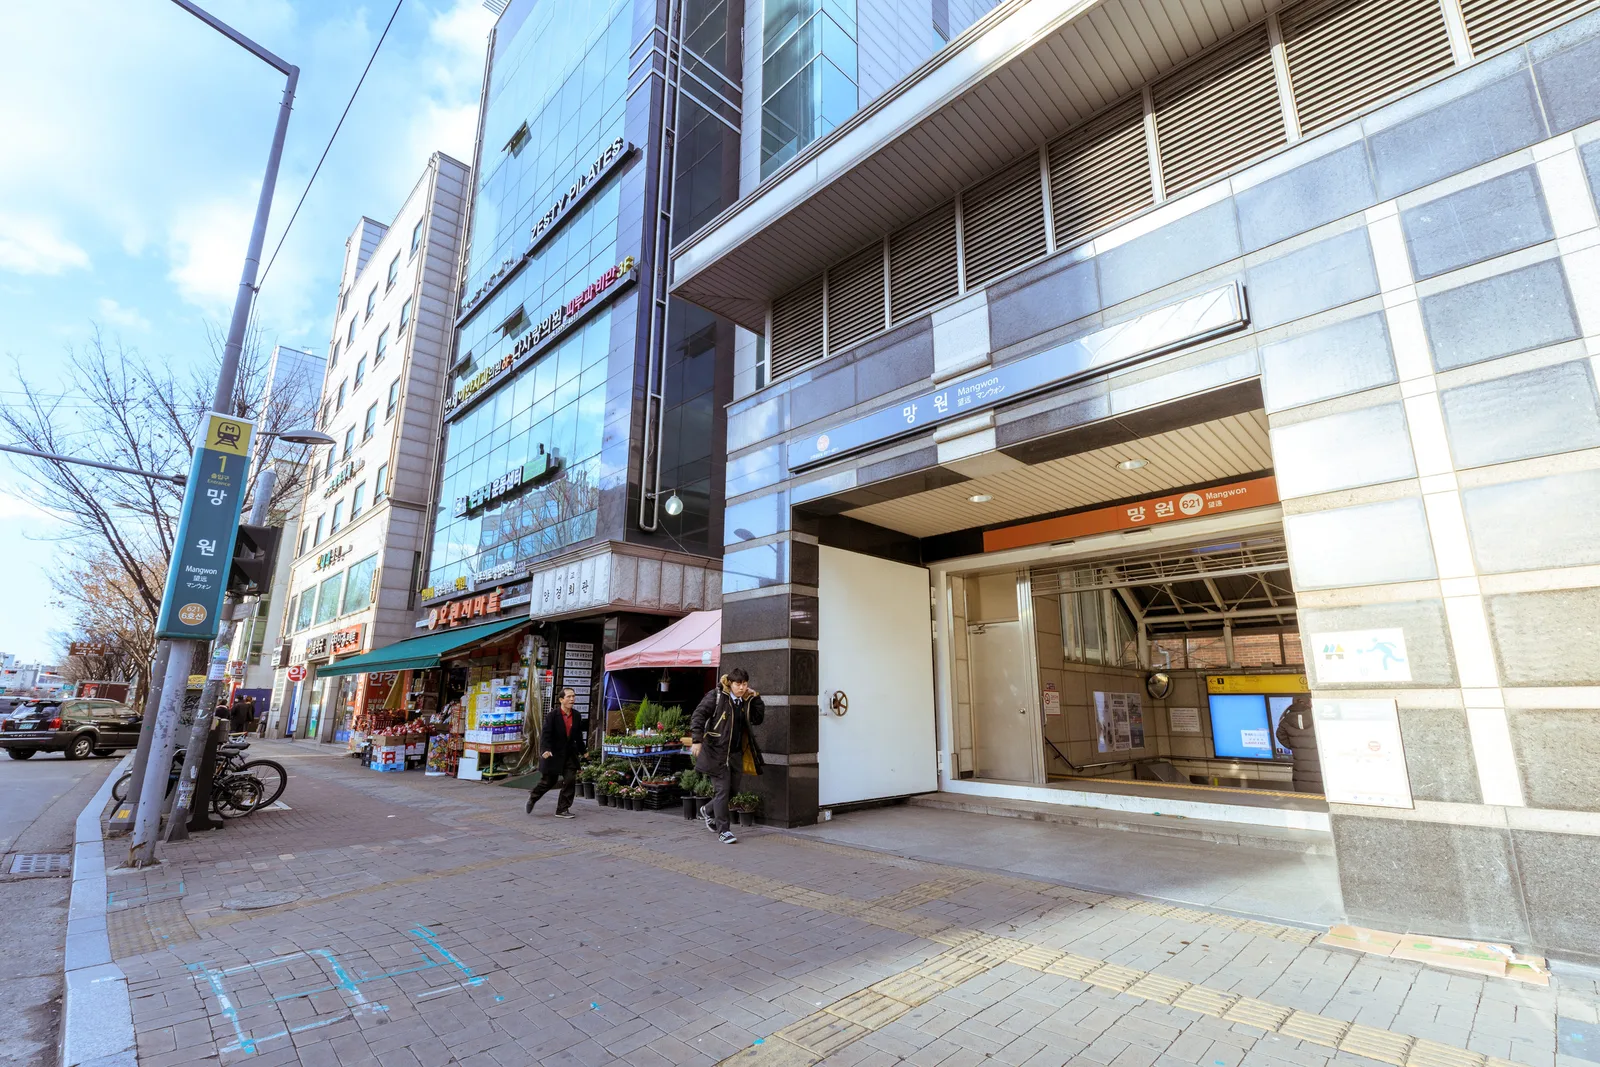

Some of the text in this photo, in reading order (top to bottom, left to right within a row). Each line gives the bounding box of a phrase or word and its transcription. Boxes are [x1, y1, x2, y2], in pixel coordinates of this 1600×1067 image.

[530, 137, 625, 240] ZESTY PILATES
[957, 377, 999, 397] Mangwon
[218, 455, 227, 473] 1
[1205, 487, 1247, 501] Mangwon
[1182, 498, 1201, 510] 621
[185, 565, 218, 576] Mangwon
[186, 605, 201, 613] 621
[181, 612, 204, 621] 6호선
[289, 667, 305, 681] 약
